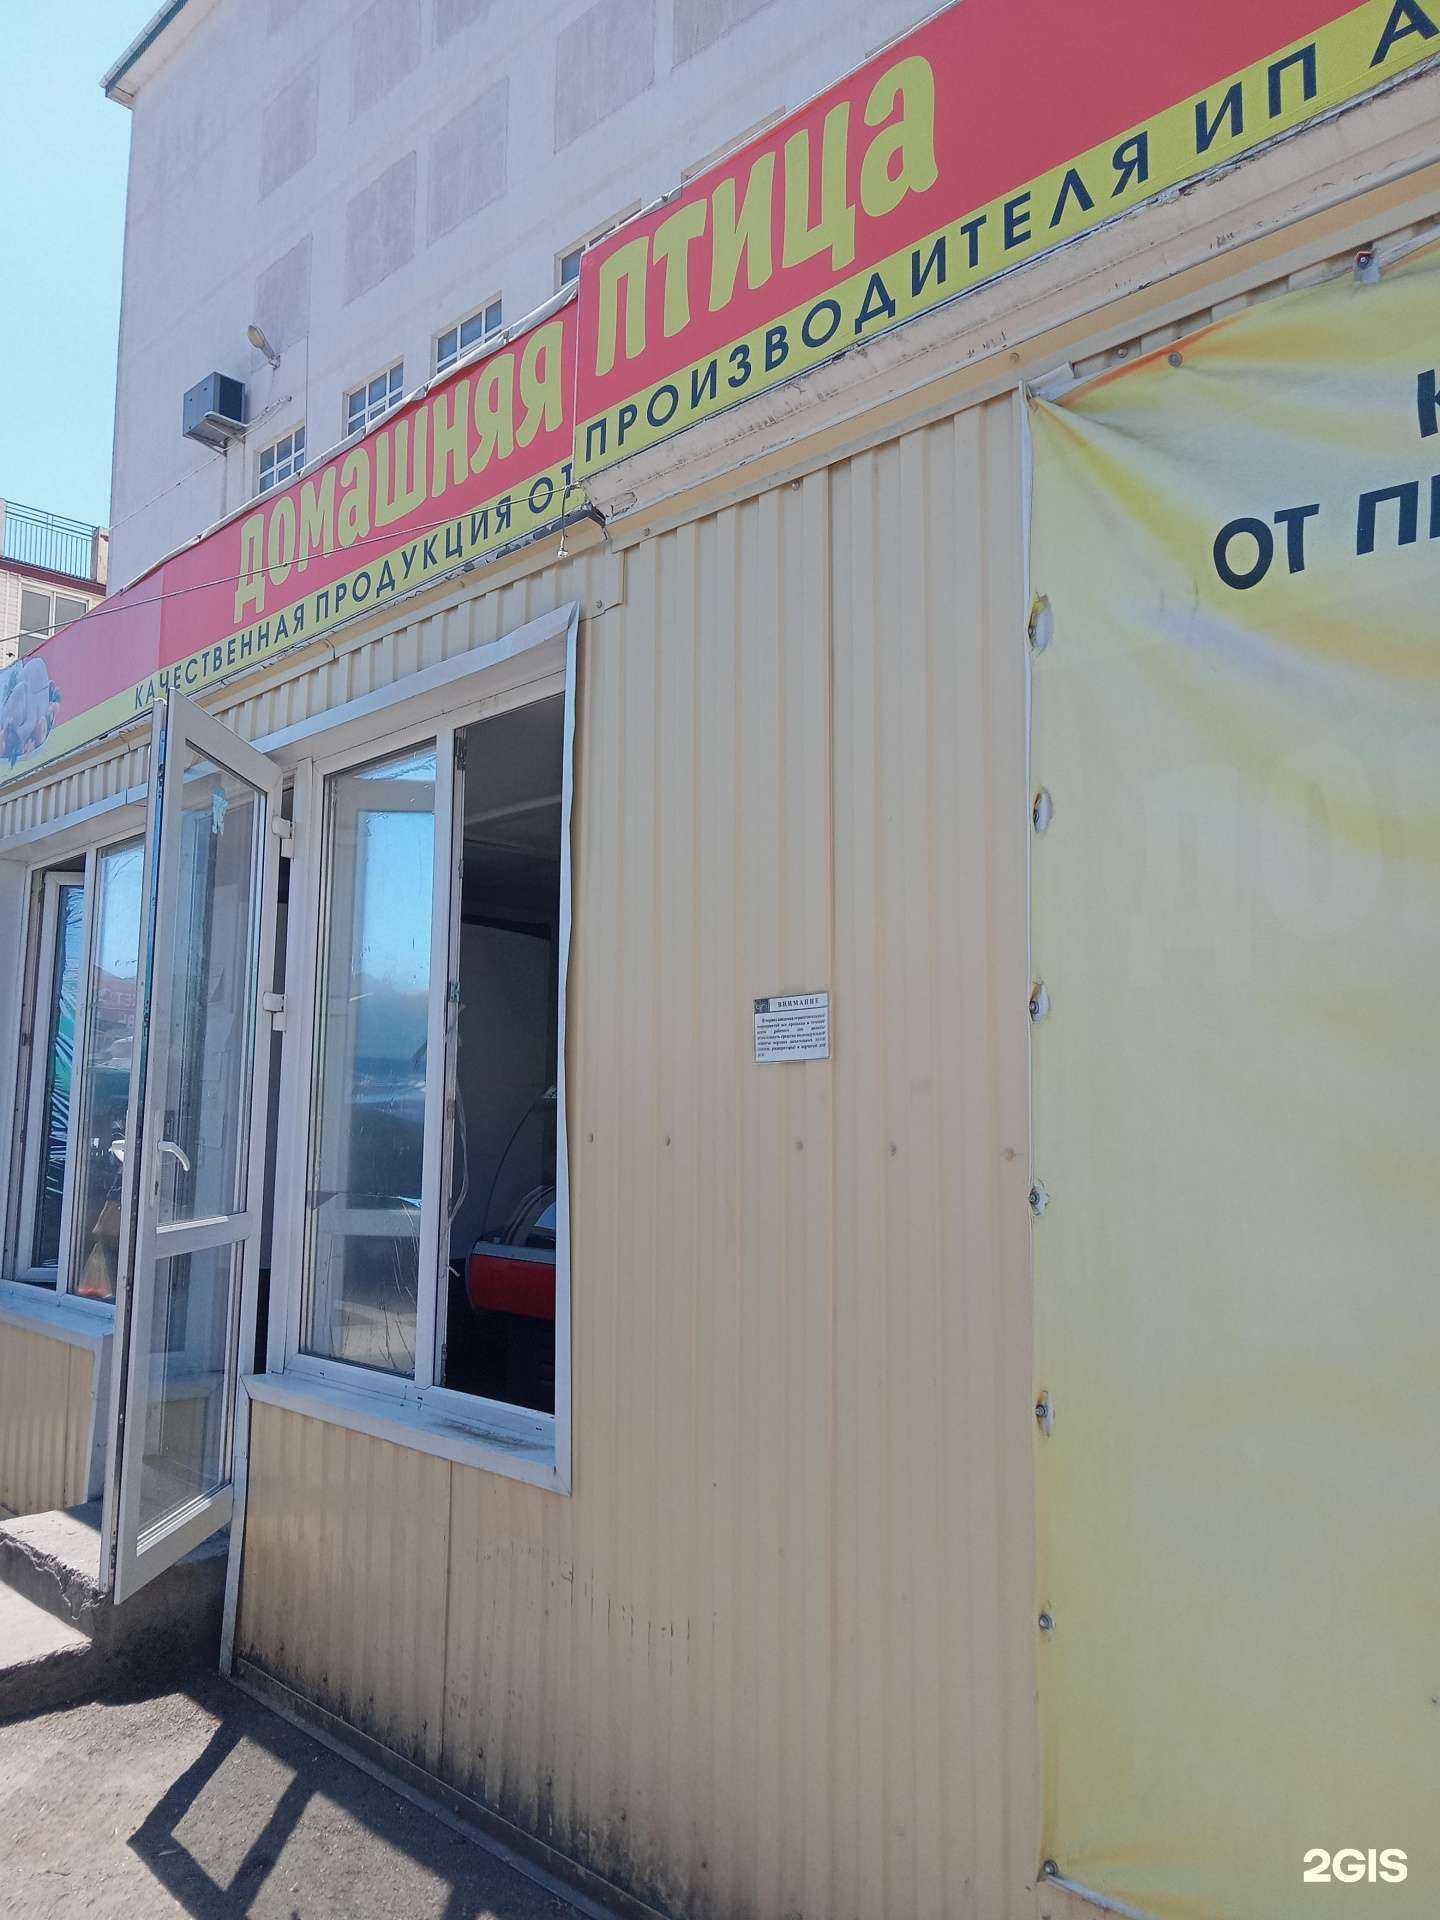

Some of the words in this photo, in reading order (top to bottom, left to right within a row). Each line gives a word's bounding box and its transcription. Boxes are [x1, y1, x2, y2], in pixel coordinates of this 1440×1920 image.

[135, 603, 304, 709] КАЧЕСТВЕННАЯ
[316, 496, 511, 622] ПРОДУКЦИЯ
[528, 463, 573, 514] ОТ
[585, 130, 1148, 462] ПРОИЗВОДИТЕЛЯ
[1195, 42, 1316, 154] ИП
[1213, 503, 1320, 590] ОТ
[1356, 474, 1440, 556] П
[777, 998, 819, 1007] ВНИМАНИЕ
